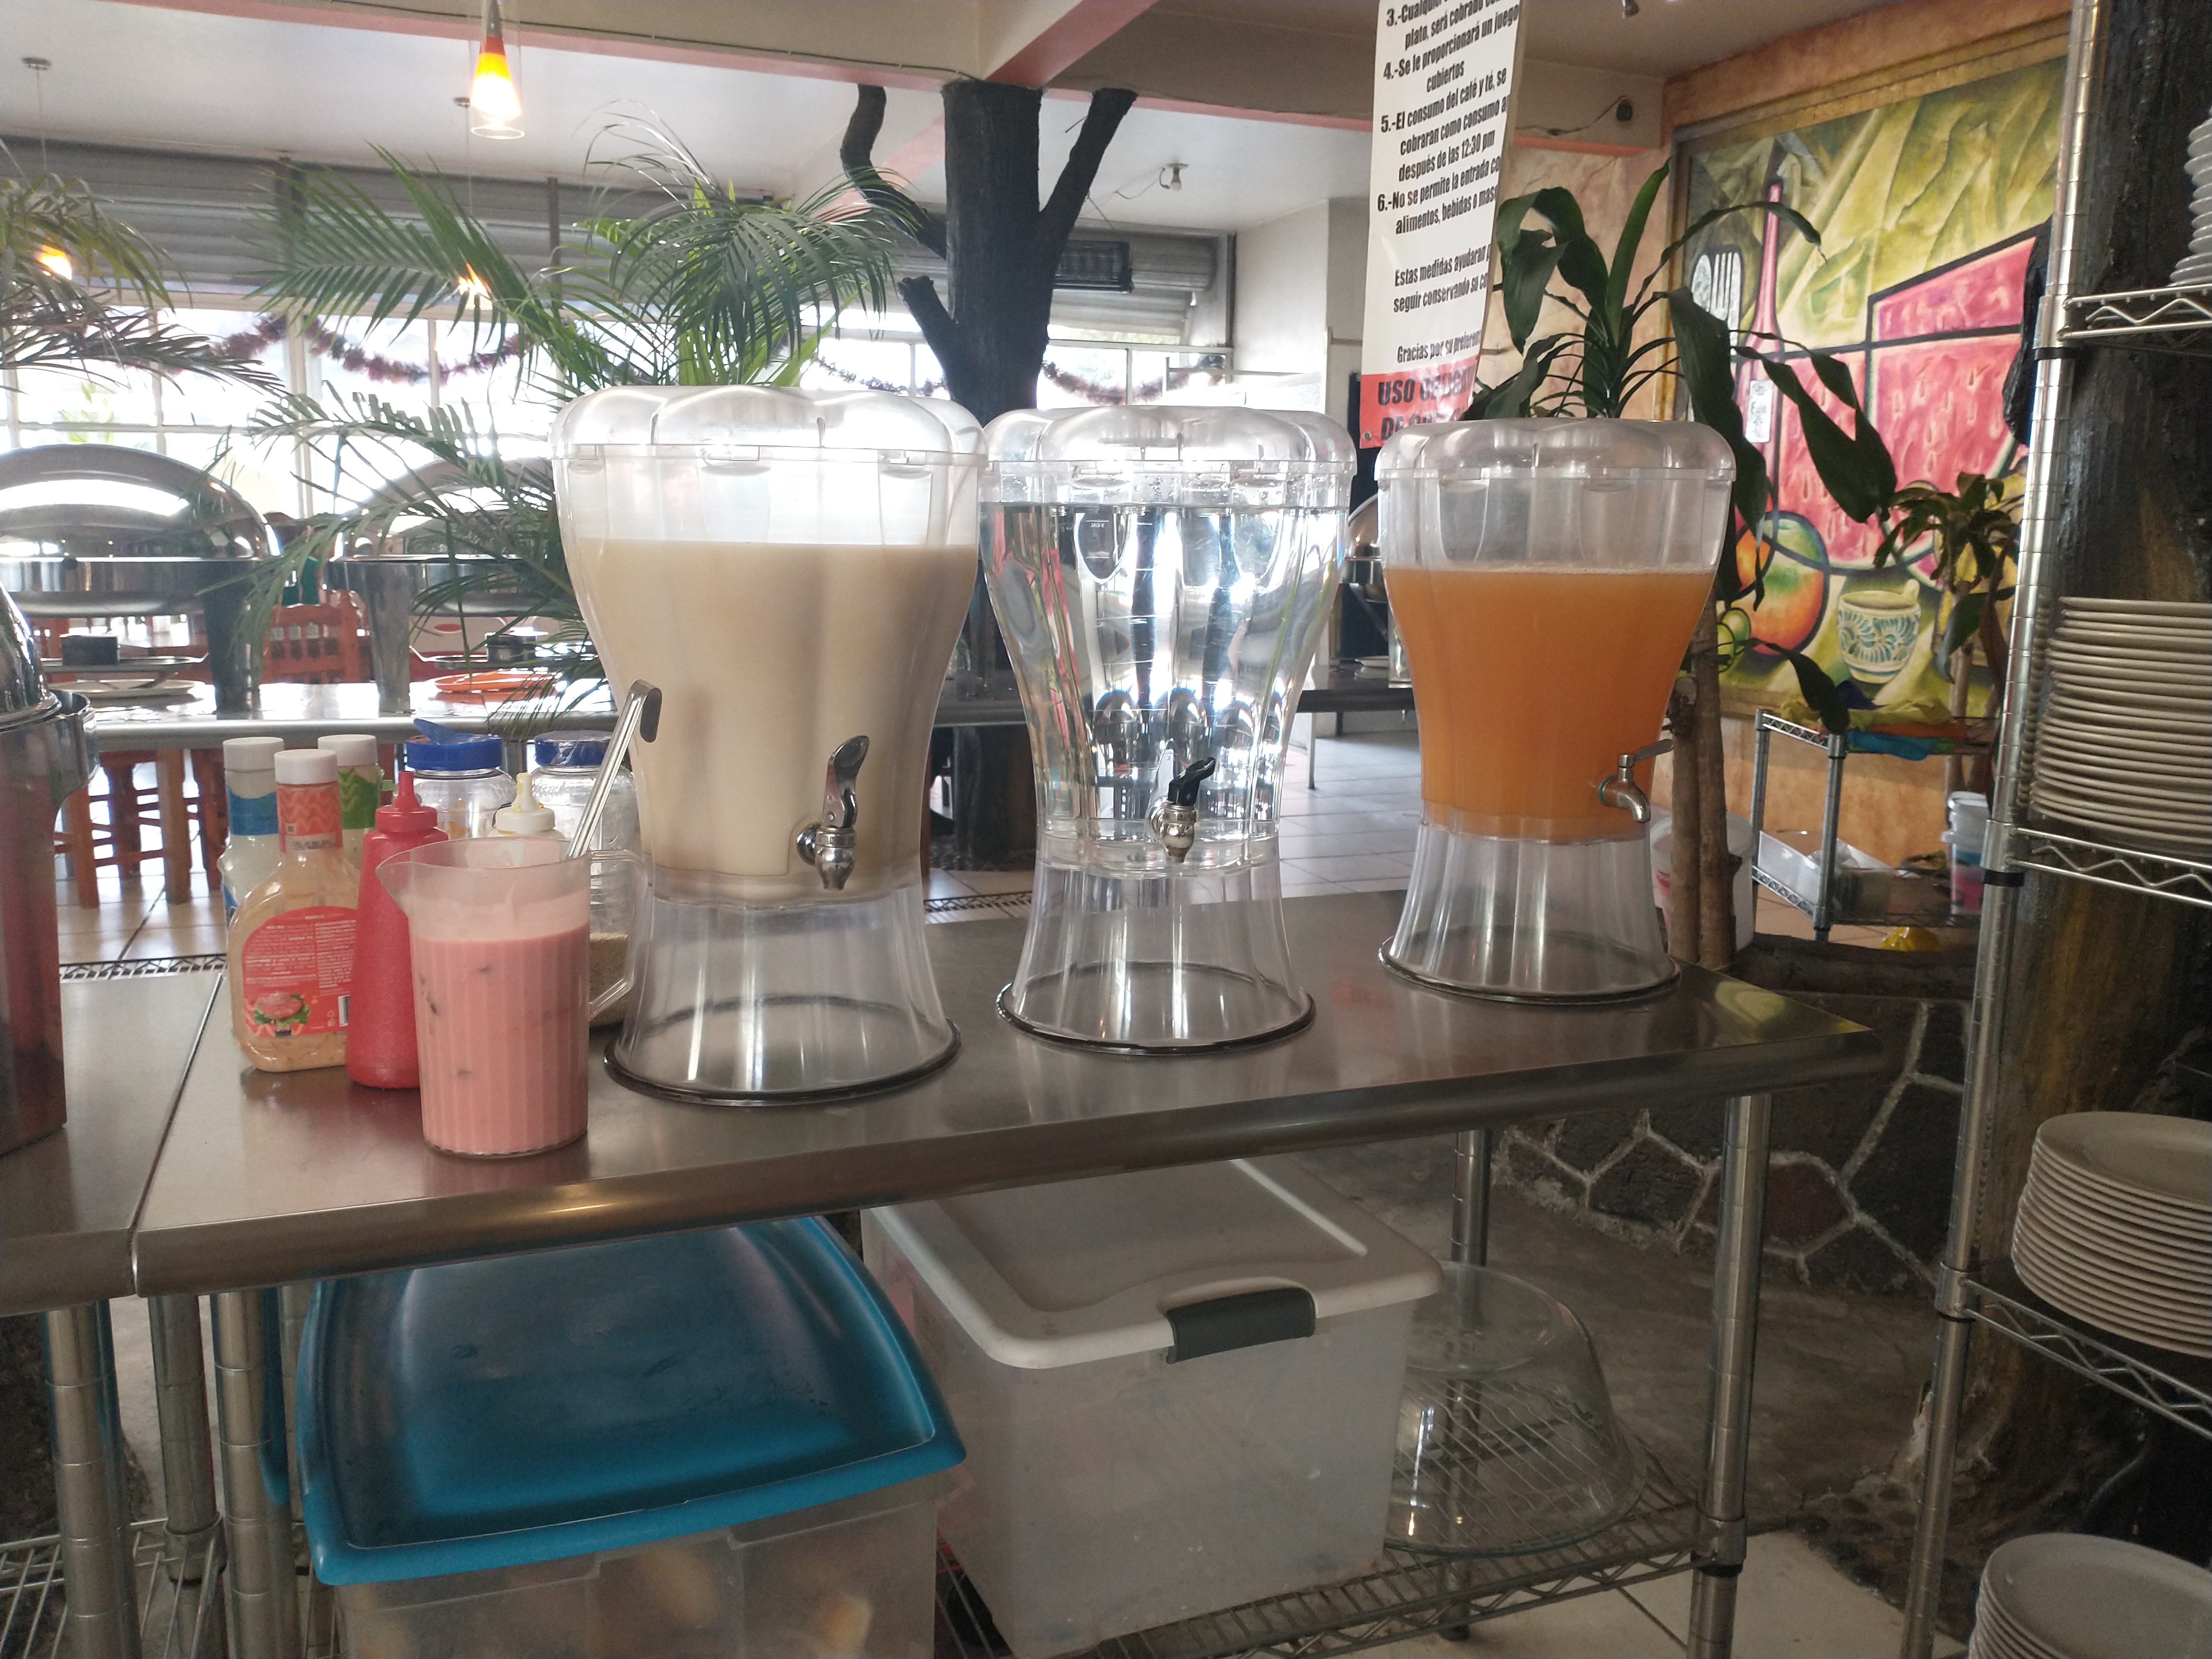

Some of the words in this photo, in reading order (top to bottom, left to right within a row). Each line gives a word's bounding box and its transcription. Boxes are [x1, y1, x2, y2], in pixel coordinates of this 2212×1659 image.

[1383, 59, 1410, 80] 4.-Se
[1413, 54, 1420, 73] le
[1422, 21, 1479, 71] proporcionará
[1482, 18, 1492, 37] un
[1494, 4, 1519, 35] juego
[1405, 25, 1429, 51] plato,
[1431, 10, 1448, 36] será
[1427, 60, 1465, 93] cubiertos
[1381, 111, 1405, 132] 5.-El
[1407, 98, 1444, 127] consumo
[1446, 88, 1458, 110] del
[1460, 78, 1477, 104] café
[1479, 78, 1484, 97] y
[1485, 70, 1495, 93] té,
[1497, 68, 1506, 87] se
[1400, 127, 1439, 156] cobraran
[1441, 118, 1461, 141] como
[1463, 99, 1500, 131] consumo
[1399, 154, 1435, 182] después
[1437, 150, 1446, 169] de
[1448, 145, 1460, 165] las
[1461, 133, 1481, 159] 12:30
[1482, 130, 1495, 153] pm
[1377, 191, 1405, 212] 6.-No
[1407, 189, 1418, 206] se
[1420, 177, 1450, 204] permite
[1452, 171, 1459, 191] la
[1460, 159, 1490, 187] entrada
[1395, 208, 1441, 234] alimentos,
[1442, 195, 1471, 221] bebidas
[1473, 193, 1477, 209] o
[1395, 267, 1418, 287] Estas
[1419, 257, 1453, 282] medidas
[1454, 245, 1486, 272] ayudaran
[1393, 291, 1421, 313] seguir
[1423, 277, 1470, 307] conservando
[1470, 276, 1479, 293] su
[1397, 343, 1428, 363] Gracias
[1430, 342, 1444, 360] por
[1445, 338, 1453, 354] su
[1378, 378, 1415, 406] USO
